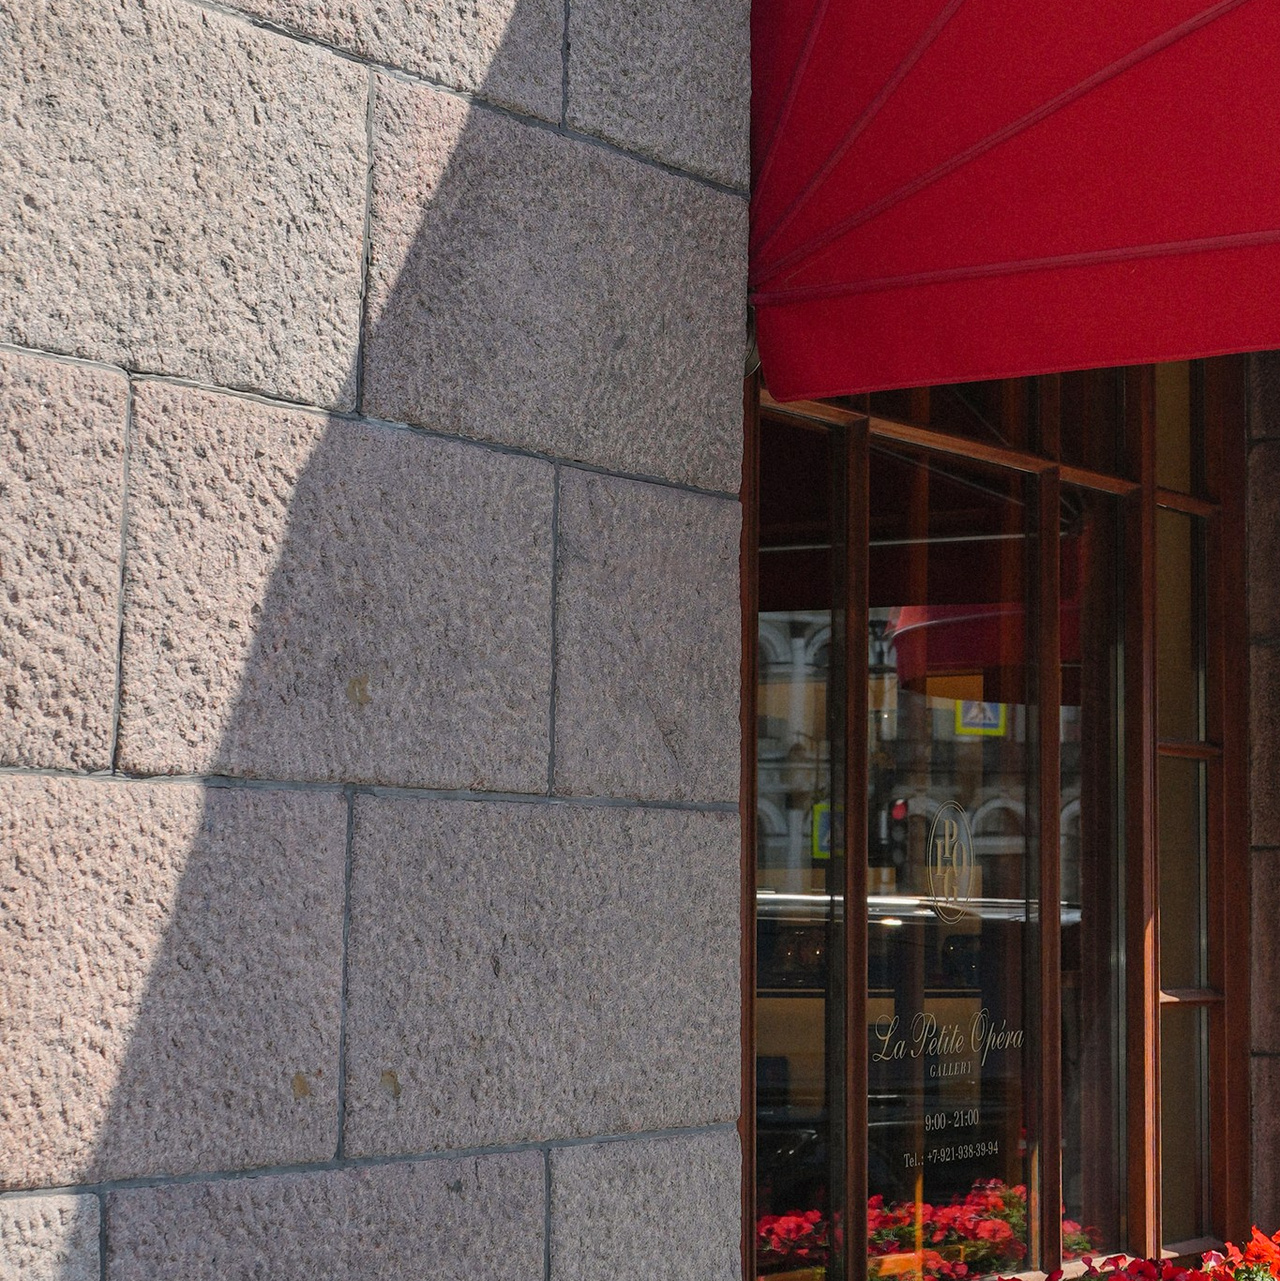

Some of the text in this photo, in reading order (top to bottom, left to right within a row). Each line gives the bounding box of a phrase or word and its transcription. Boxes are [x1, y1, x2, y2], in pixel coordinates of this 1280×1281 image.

[872, 1007, 1026, 1067] La Petite Opéra
[930, 1061, 974, 1079] GALLERY
[925, 1112, 946, 1131] 9:00
[954, 1108, 979, 1127] 21:00
[903, 1140, 999, 1168] Tel.: +7-921-938-39-94
